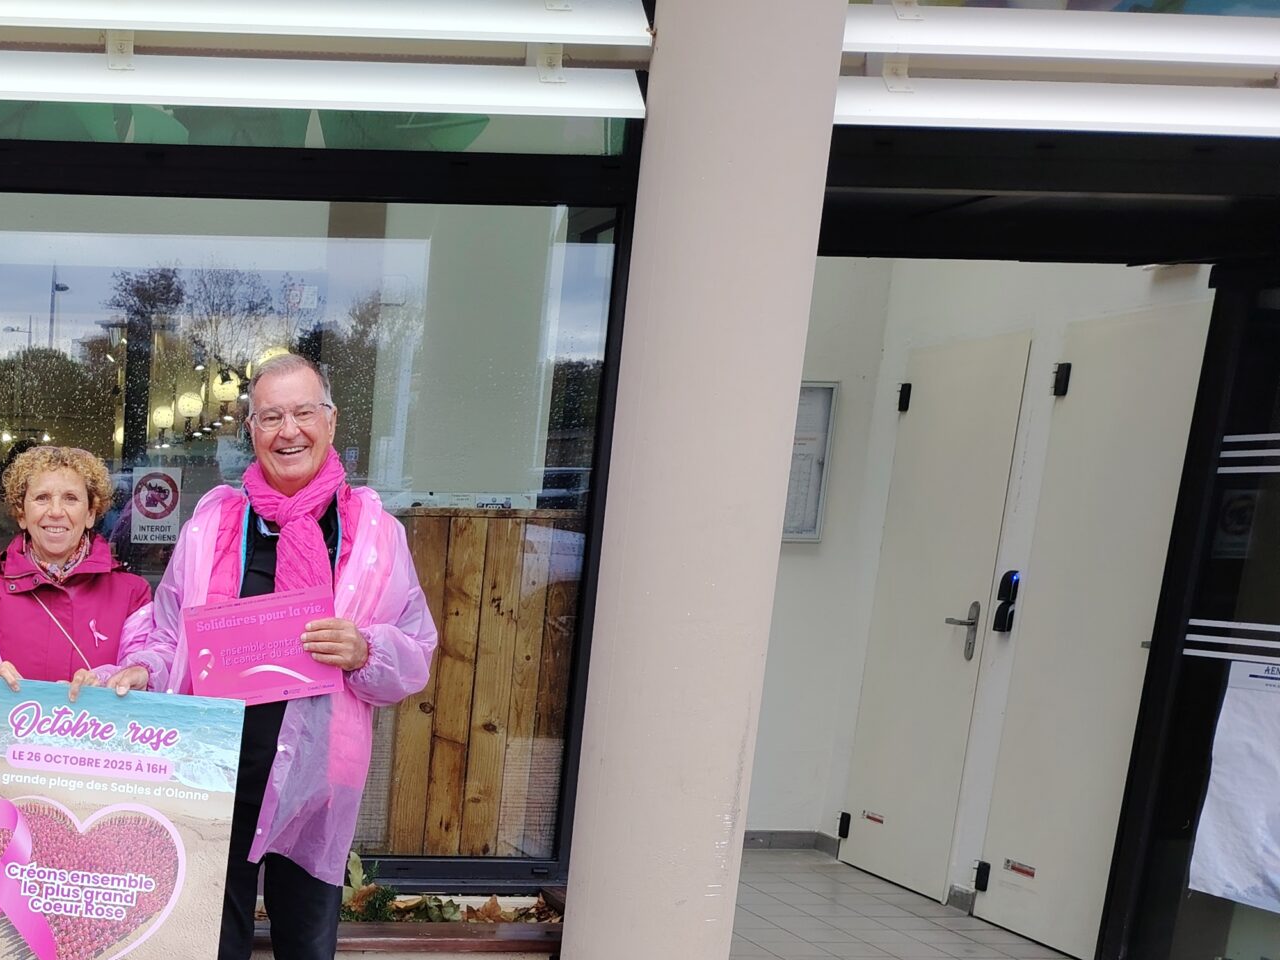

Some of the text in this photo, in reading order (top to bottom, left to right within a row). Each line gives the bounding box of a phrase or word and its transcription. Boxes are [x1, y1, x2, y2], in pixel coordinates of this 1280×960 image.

[196, 615, 257, 633] Solidaires
[258, 608, 287, 625] pour
[289, 606, 301, 617] la
[220, 637, 301, 657] ensemble contre
[223, 645, 305, 667] le cancer du sein
[8, 701, 181, 751] Octobre rose
[12, 750, 167, 775] LE 26 OCTOBRE 2025 À 16H
[2, 772, 46, 784] grande
[48, 777, 83, 791] plage
[86, 780, 108, 791] des
[111, 782, 151, 795] Sables
[153, 786, 209, 800] d'Olonne
[7, 862, 154, 890] Créons ensemble
[22, 881, 136, 904] le plus grand
[30, 898, 125, 919] Coeur Rose
